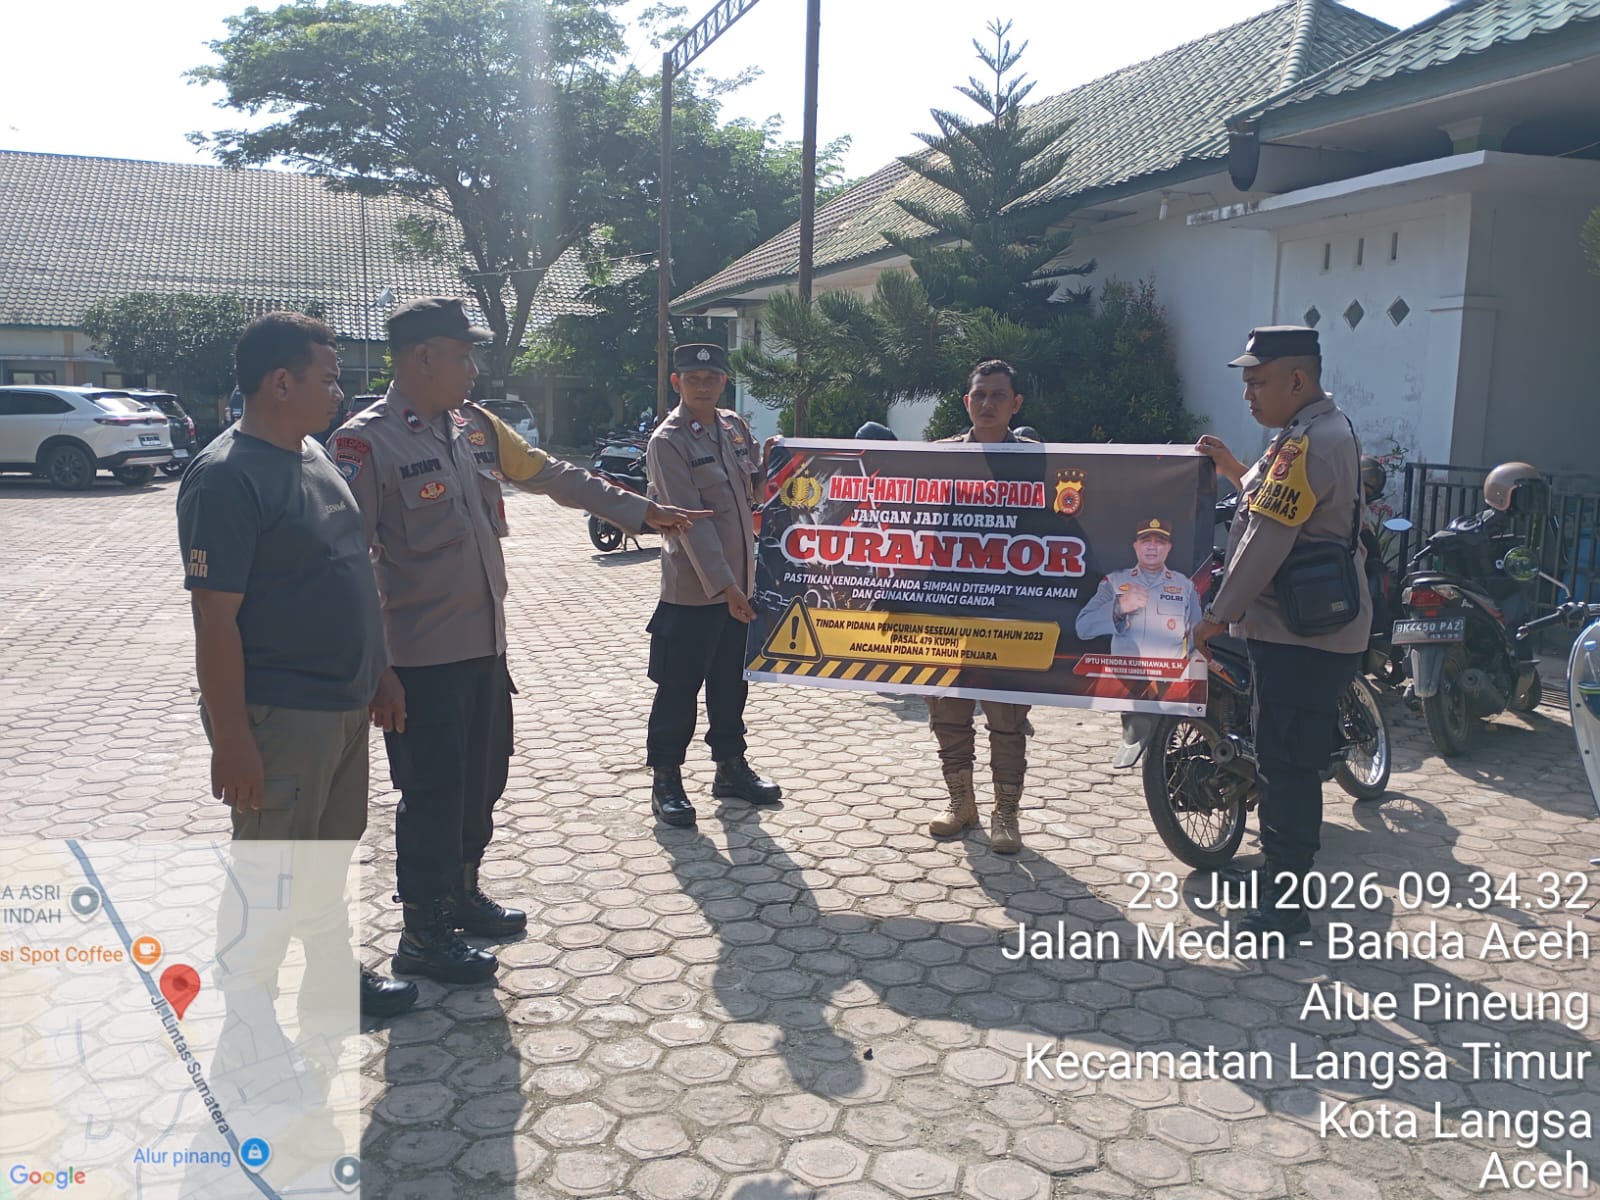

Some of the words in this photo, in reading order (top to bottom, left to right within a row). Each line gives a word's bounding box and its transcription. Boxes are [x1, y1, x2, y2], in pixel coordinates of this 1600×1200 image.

[829, 476, 913, 503] HATI-HATI
[914, 477, 953, 505] DAN
[955, 478, 1045, 508] WASPADA
[851, 509, 912, 524] JANGAN
[913, 511, 949, 526] JADI
[952, 513, 1018, 528] KORBAN
[783, 525, 1085, 576] CURANMOR
[784, 572, 831, 585] PASTIKAN
[832, 575, 891, 588] KENDARAAN
[892, 579, 920, 590] ANDA
[922, 581, 962, 593] SIMPAN
[962, 583, 1014, 595] DITEMPAT
[1014, 585, 1043, 597] YANG
[1043, 587, 1078, 599] AMAN
[851, 588, 872, 599] DAN
[874, 589, 925, 602] GUNAKAN
[924, 592, 957, 604] KUNCI
[960, 595, 995, 607] GANDA
[816, 618, 845, 629] TINDAK
[846, 620, 876, 631] PIDANA
[877, 623, 923, 634] PENCURIAN
[924, 625, 958, 636] SESEUAI
[959, 627, 971, 637] UU
[973, 627, 992, 639] NO.1
[993, 629, 1023, 640] TAHUN
[1023, 630, 1043, 641] 2023
[890, 635, 917, 645] (PASAL
[919, 637, 933, 646] 479
[934, 637, 959, 648] KUPH)
[849, 642, 892, 655] ANCAMAN
[893, 645, 924, 656] PIDANA
[925, 646, 930, 656] 7
[931, 647, 959, 658] TAHUN
[961, 650, 997, 661] PENJARA
[1100, 658, 1127, 667] HENDRA
